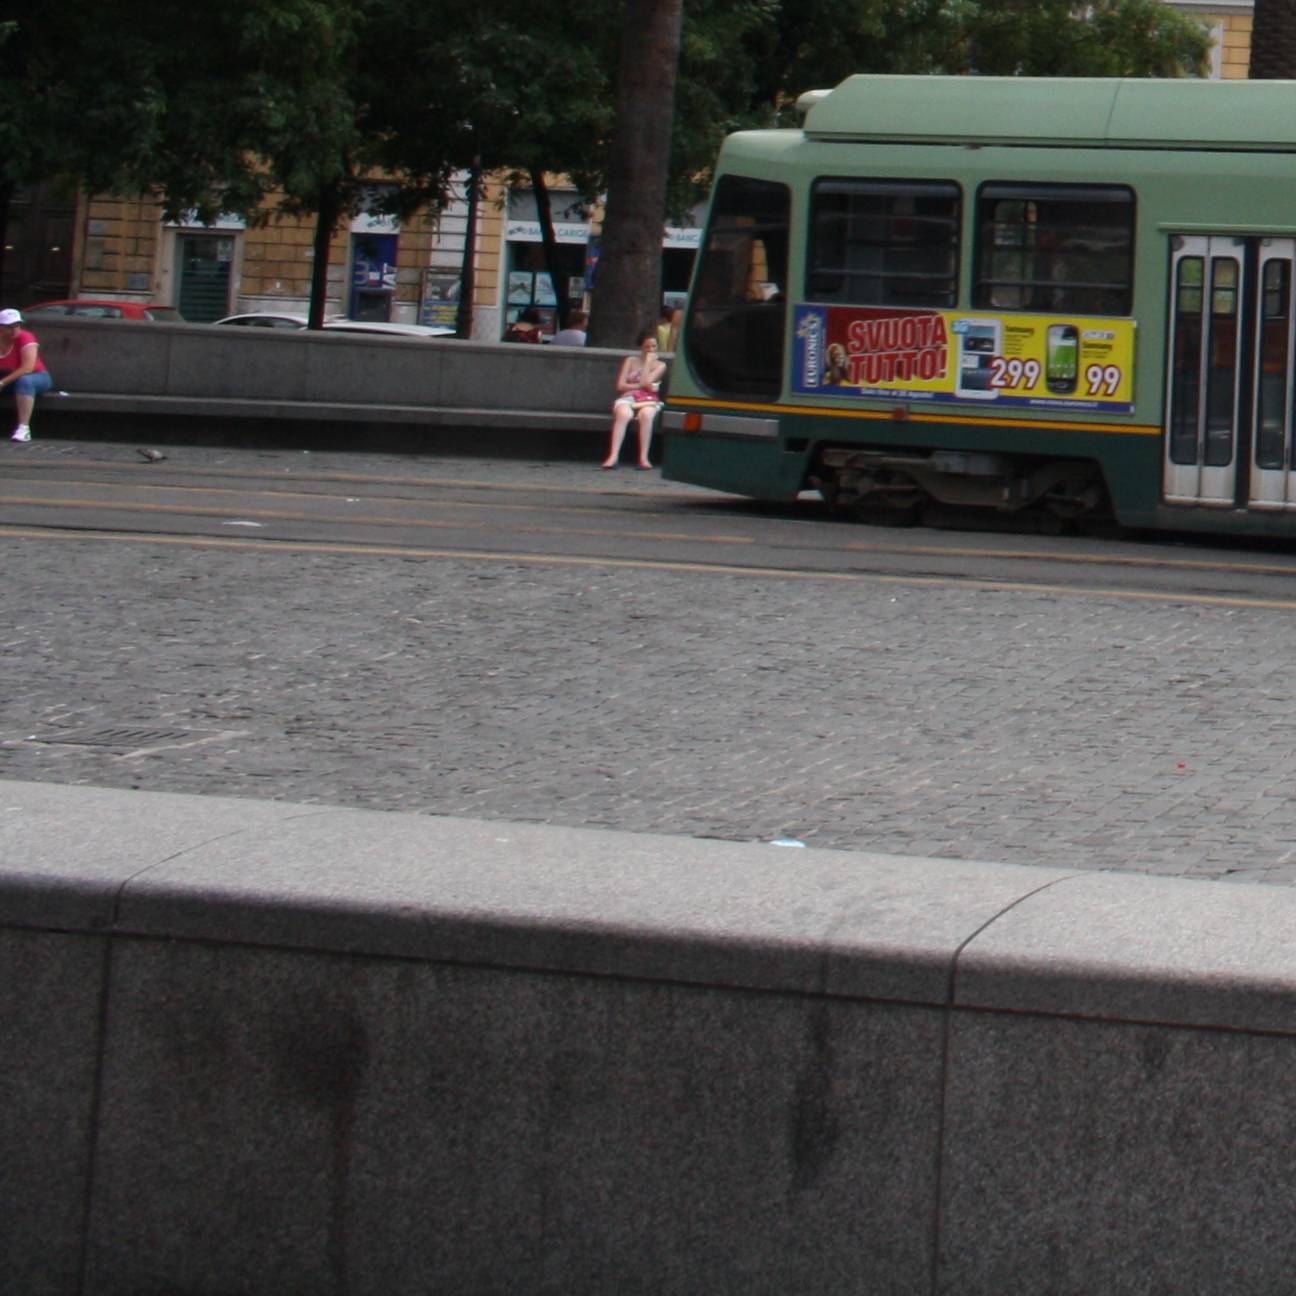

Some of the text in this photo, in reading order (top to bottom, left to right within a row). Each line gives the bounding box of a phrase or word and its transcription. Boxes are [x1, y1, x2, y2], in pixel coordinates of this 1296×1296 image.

[849, 314, 948, 354] SVUOTA
[806, 320, 820, 387] EURONICS
[848, 348, 948, 385] TUTTO!
[989, 357, 1041, 390] 299
[1086, 364, 1121, 396] 99
